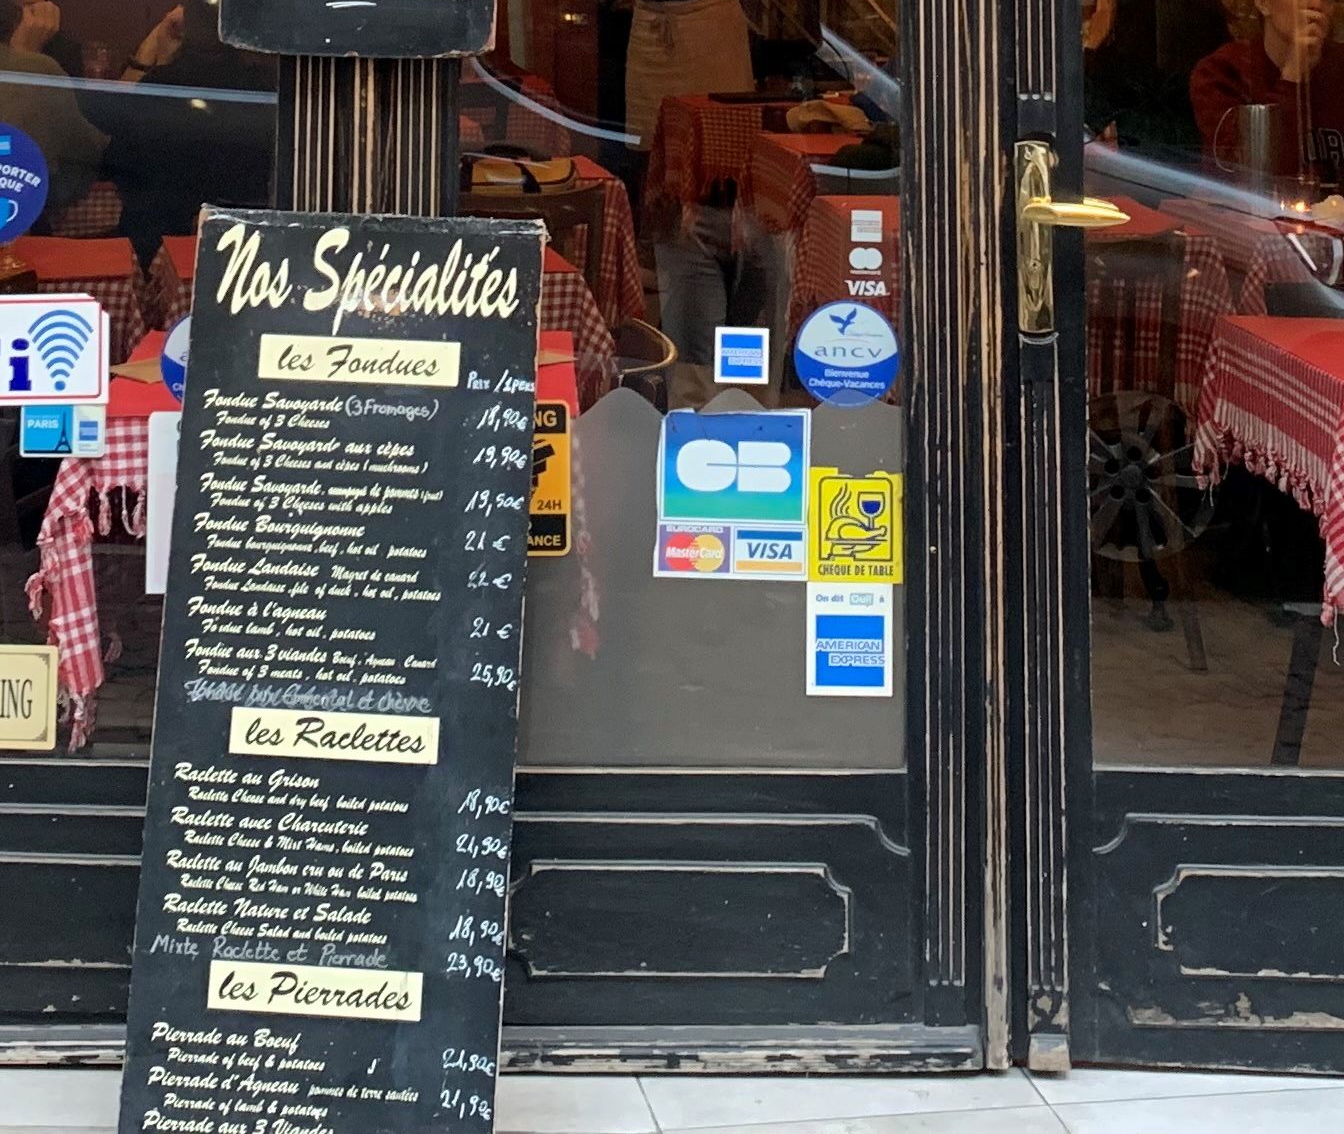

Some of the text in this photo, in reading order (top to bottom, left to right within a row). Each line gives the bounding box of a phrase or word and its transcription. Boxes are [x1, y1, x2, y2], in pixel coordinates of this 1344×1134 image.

[216, 224, 520, 335] Nos Spécialités
[844, 280, 890, 296] VISA
[277, 345, 440, 376] les Fondues
[814, 346, 882, 358] ancv
[203, 389, 258, 408] Fondue
[262, 392, 344, 413] Savoyarde
[27, 419, 58, 428] PARIS
[215, 412, 330, 430] Fondue of 3 Cheeses
[537, 500, 562, 510] 24H
[194, 513, 365, 543] Fondue Bourguignonne
[666, 546, 722, 558] MasterCard
[747, 542, 792, 559] VISA
[855, 566, 866, 576] DE
[868, 566, 893, 576] TABLE
[816, 594, 843, 603] On dit
[187, 597, 327, 621] Fondue à l'agneau
[816, 640, 881, 651] AMERICAN
[830, 655, 885, 665] EXPRESS
[245, 717, 425, 754] les Raclettes
[174, 762, 320, 789] Raclette au Grison
[287, 946, 307, 961] et
[219, 970, 412, 1010] les Pierrades
[151, 1022, 302, 1053] Pierrade au Boeuf
